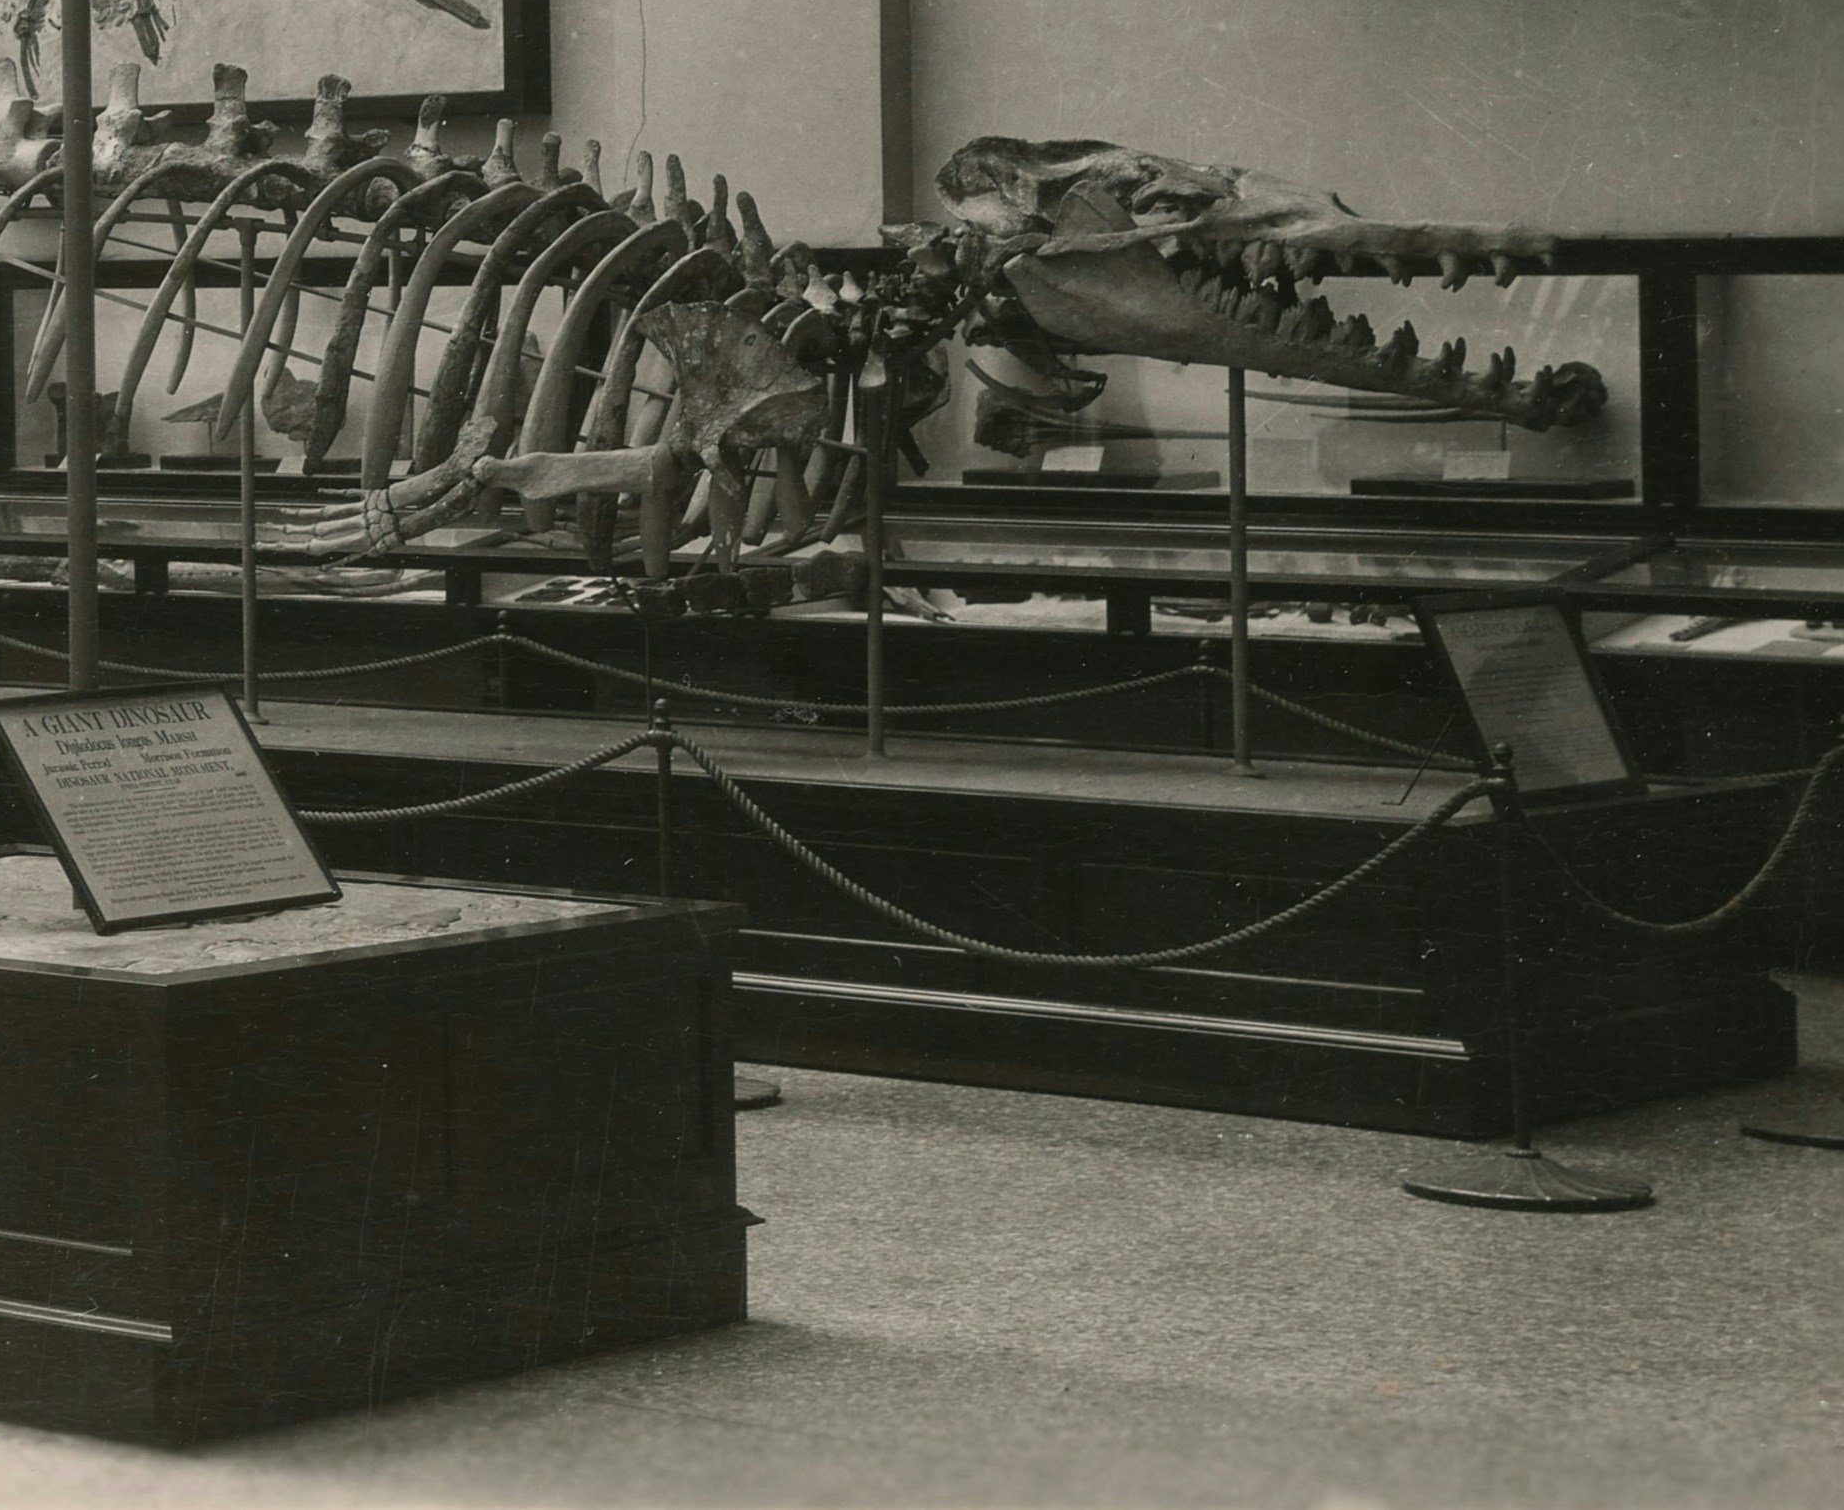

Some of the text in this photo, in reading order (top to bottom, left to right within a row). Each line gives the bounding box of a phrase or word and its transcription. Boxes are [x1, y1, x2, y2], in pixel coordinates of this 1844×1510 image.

[22, 700, 212, 737] A GIANT DINOSAUR
[54, 736, 115, 757] Diplodocus
[117, 732, 152, 751] longus
[42, 746, 232, 776] Jurassic Period Morrison Formation
[56, 775, 112, 790] DINOSAUR
[113, 769, 169, 783] NATIONAL
